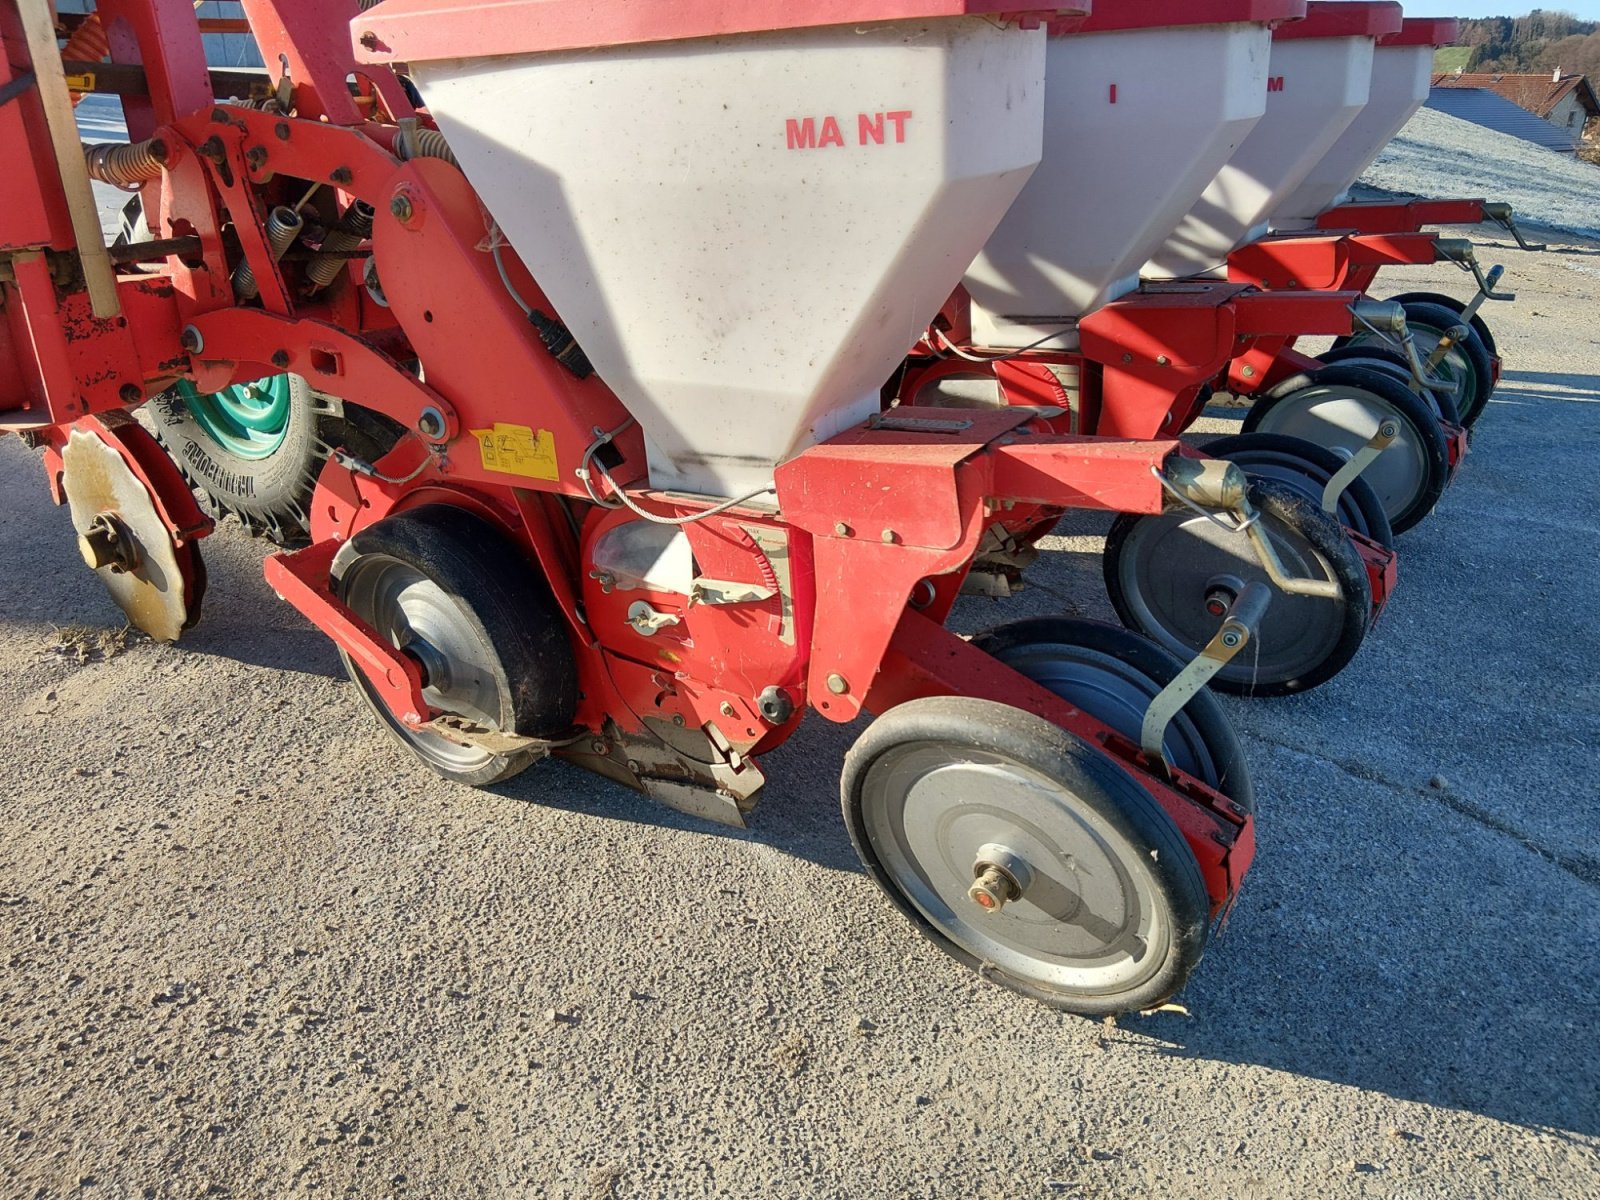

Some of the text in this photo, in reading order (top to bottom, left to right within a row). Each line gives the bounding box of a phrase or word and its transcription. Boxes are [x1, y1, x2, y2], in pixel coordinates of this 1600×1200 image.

[1267, 77, 1283, 92] M
[785, 110, 912, 150] MA NT
